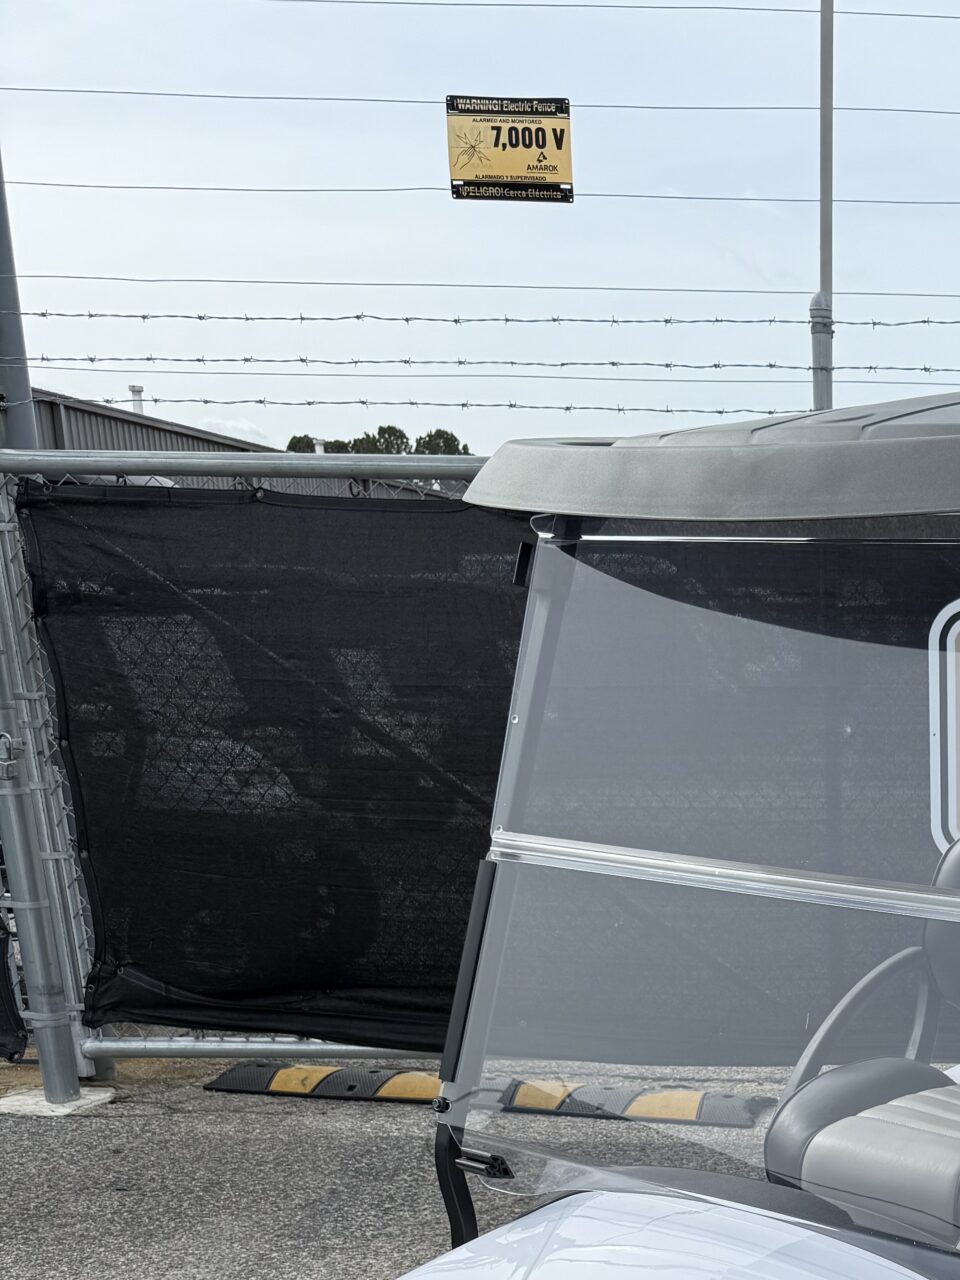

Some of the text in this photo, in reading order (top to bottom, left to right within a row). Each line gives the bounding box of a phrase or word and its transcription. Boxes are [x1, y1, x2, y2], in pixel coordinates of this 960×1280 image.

[457, 98, 556, 112] WARNING! Electric Fence
[491, 125, 565, 151] 7,000 V
[527, 164, 558, 172] AMAROK
[505, 188, 526, 198] Cerca
